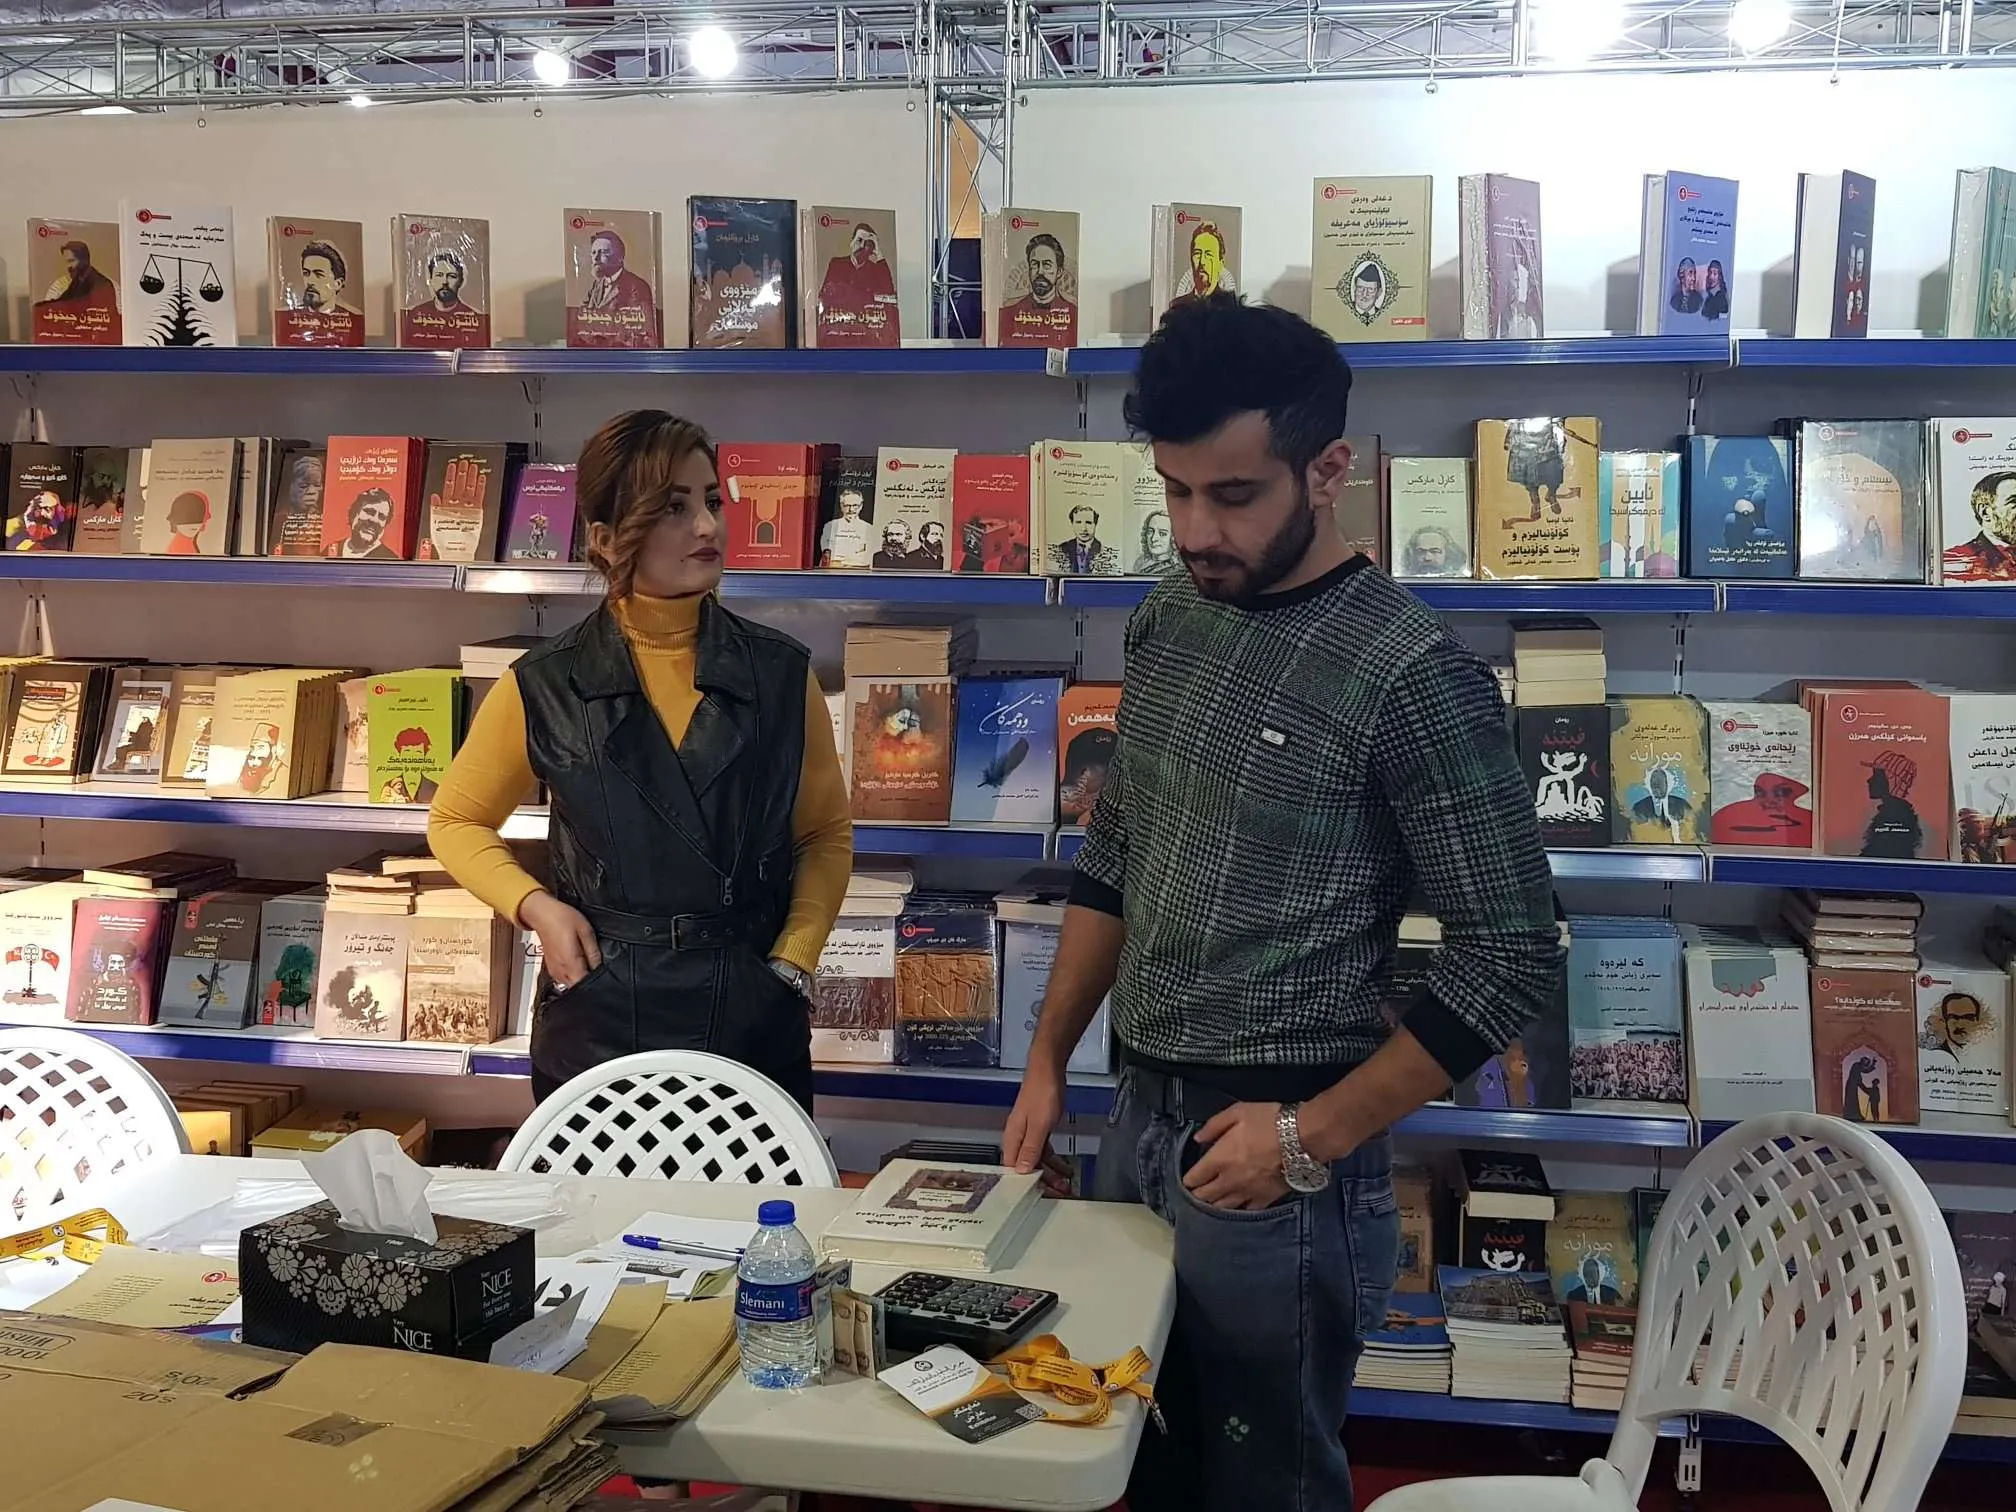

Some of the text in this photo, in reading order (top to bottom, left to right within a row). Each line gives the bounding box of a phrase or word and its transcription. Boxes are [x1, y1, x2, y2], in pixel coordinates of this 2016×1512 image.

[1067, 711, 1118, 727] بەهمەن
[482, 1267, 513, 1298] NICE
[739, 1291, 785, 1310] Slemani
[393, 1326, 433, 1352] NICE
